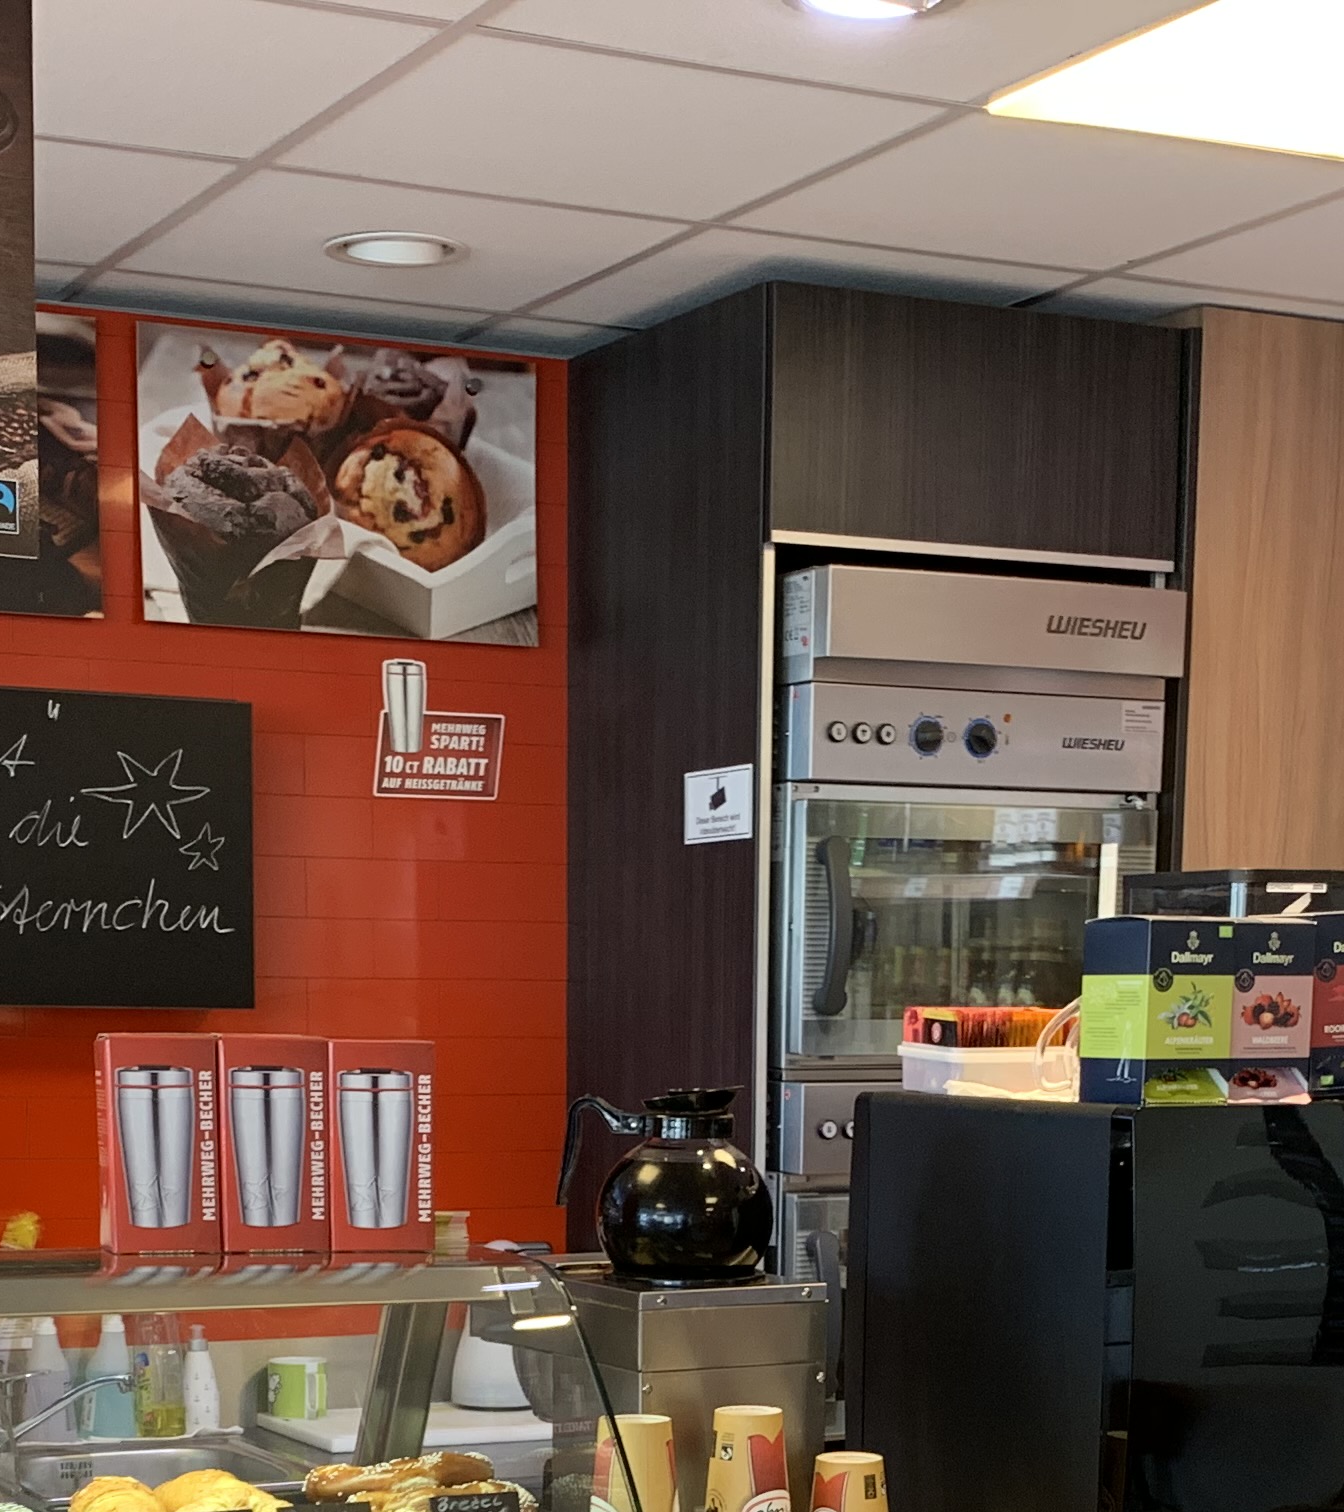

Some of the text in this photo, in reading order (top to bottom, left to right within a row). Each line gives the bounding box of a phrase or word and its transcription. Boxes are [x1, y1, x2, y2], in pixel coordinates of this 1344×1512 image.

[431, 723, 487, 735] MEHRWEG
[430, 735, 485, 751] SPART!
[384, 755, 404, 773] 10
[422, 756, 488, 776] RABATT
[381, 777, 402, 788] AUF
[1171, 951, 1214, 965] Dallmayr
[1253, 951, 1294, 966] Dallmayr
